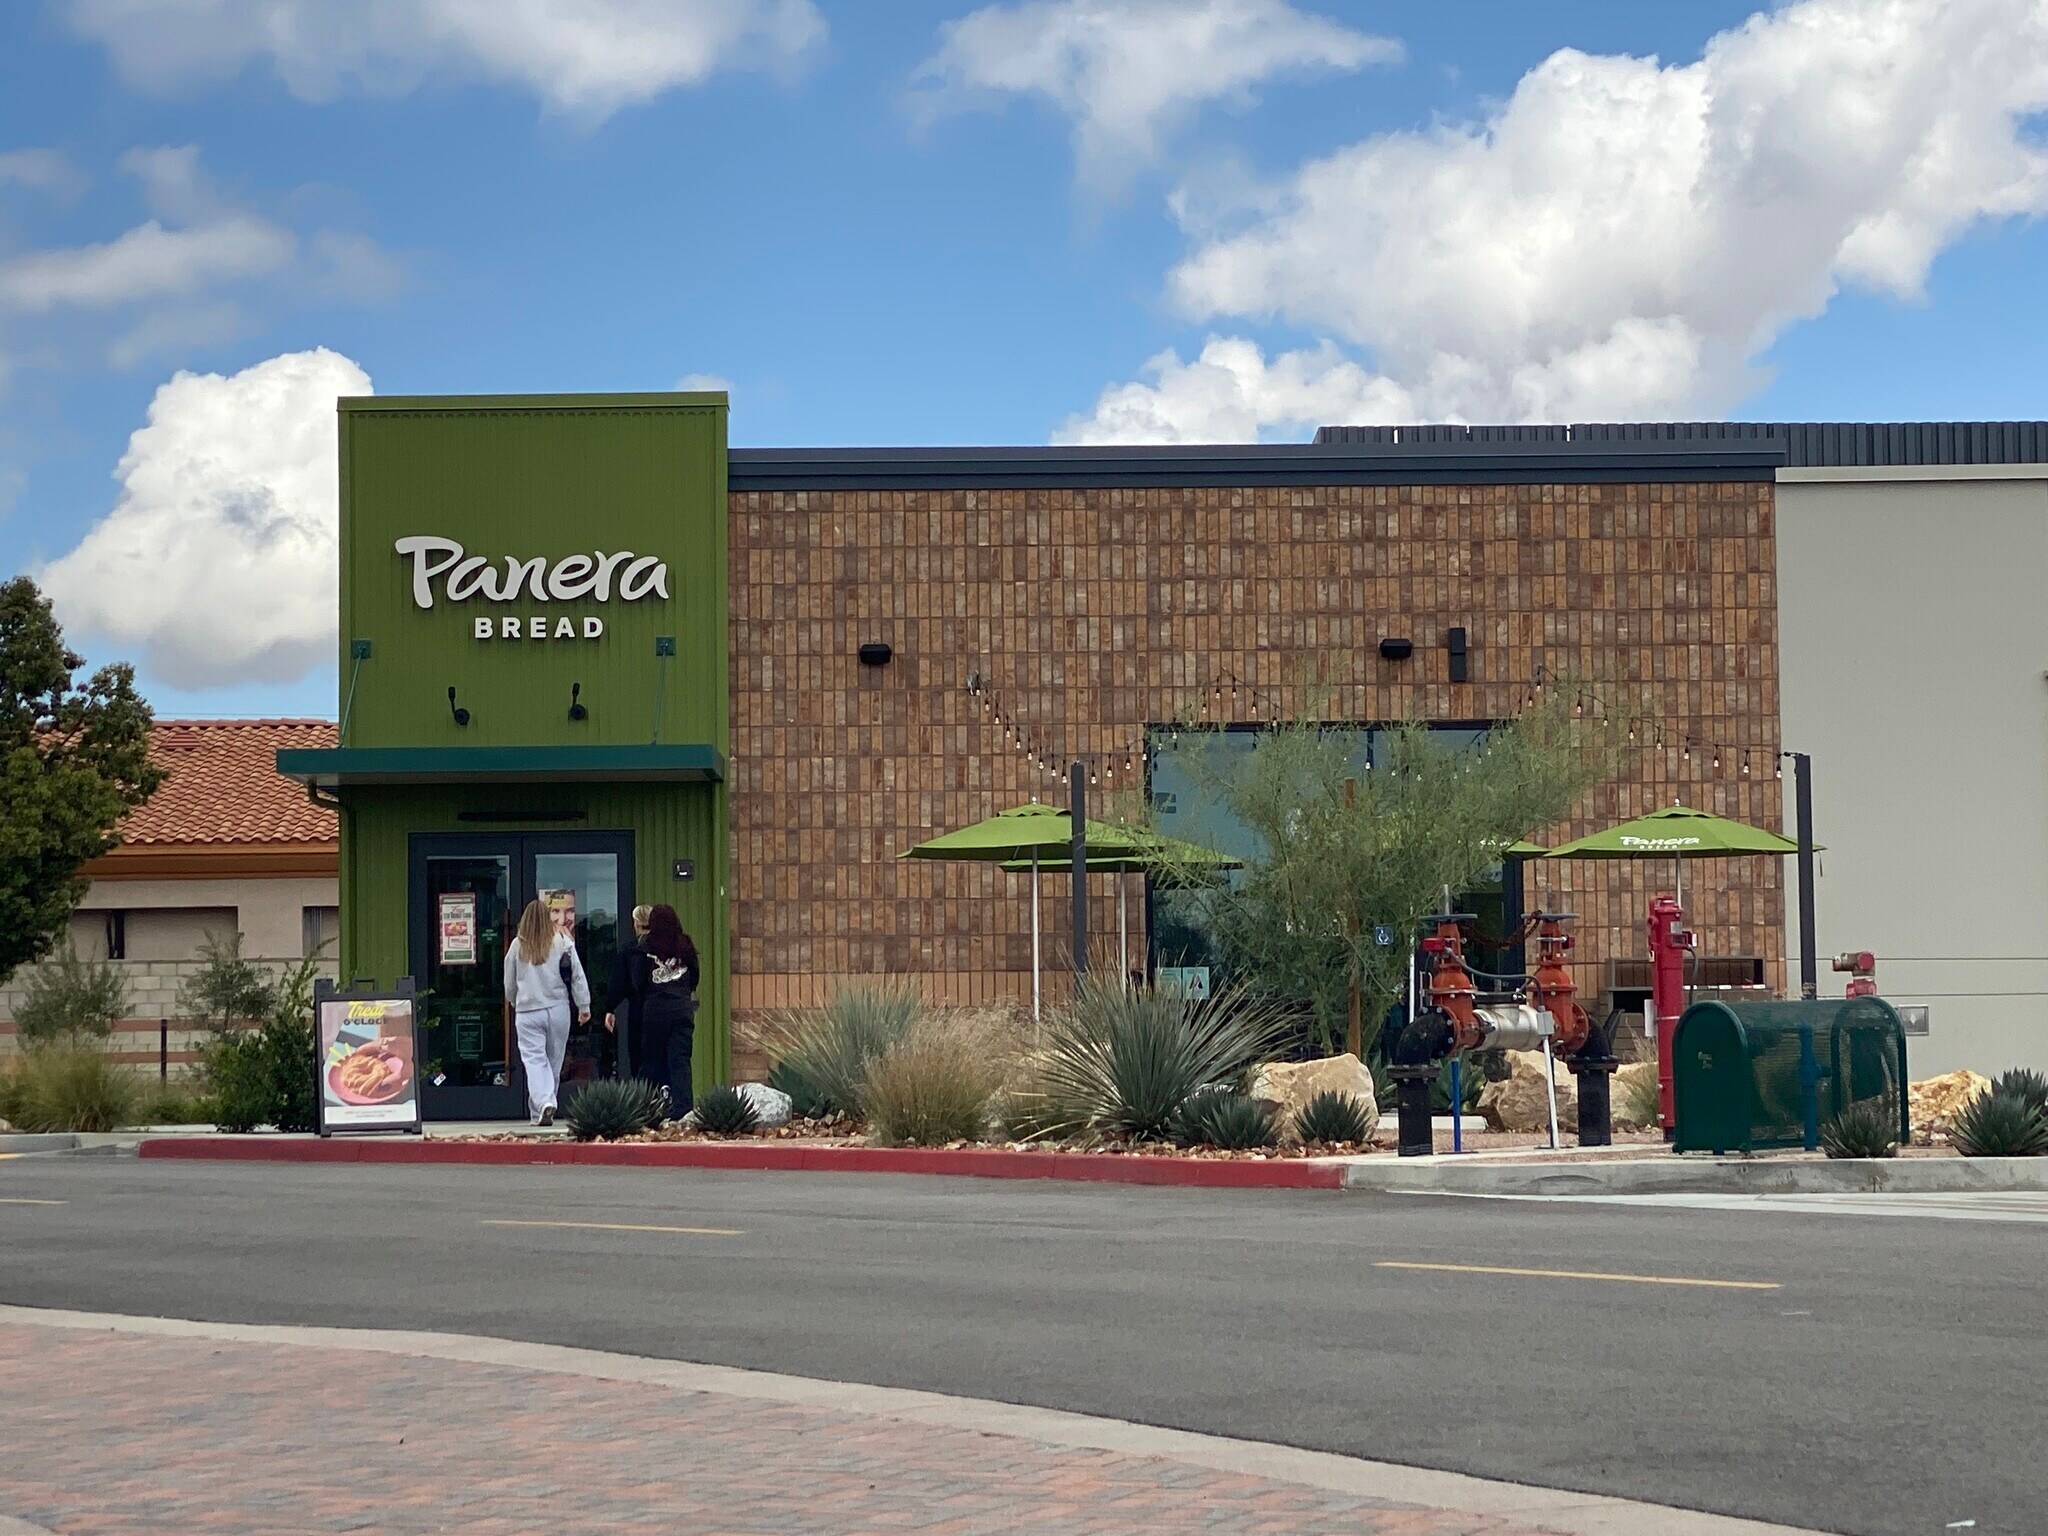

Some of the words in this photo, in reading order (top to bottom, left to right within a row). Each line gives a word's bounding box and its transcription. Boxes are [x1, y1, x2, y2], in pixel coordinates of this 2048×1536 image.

[394, 536, 669, 609] Panera
[474, 616, 603, 638] BREAD
[1620, 836, 1700, 846] Panera
[348, 1001, 386, 1019] Treat
